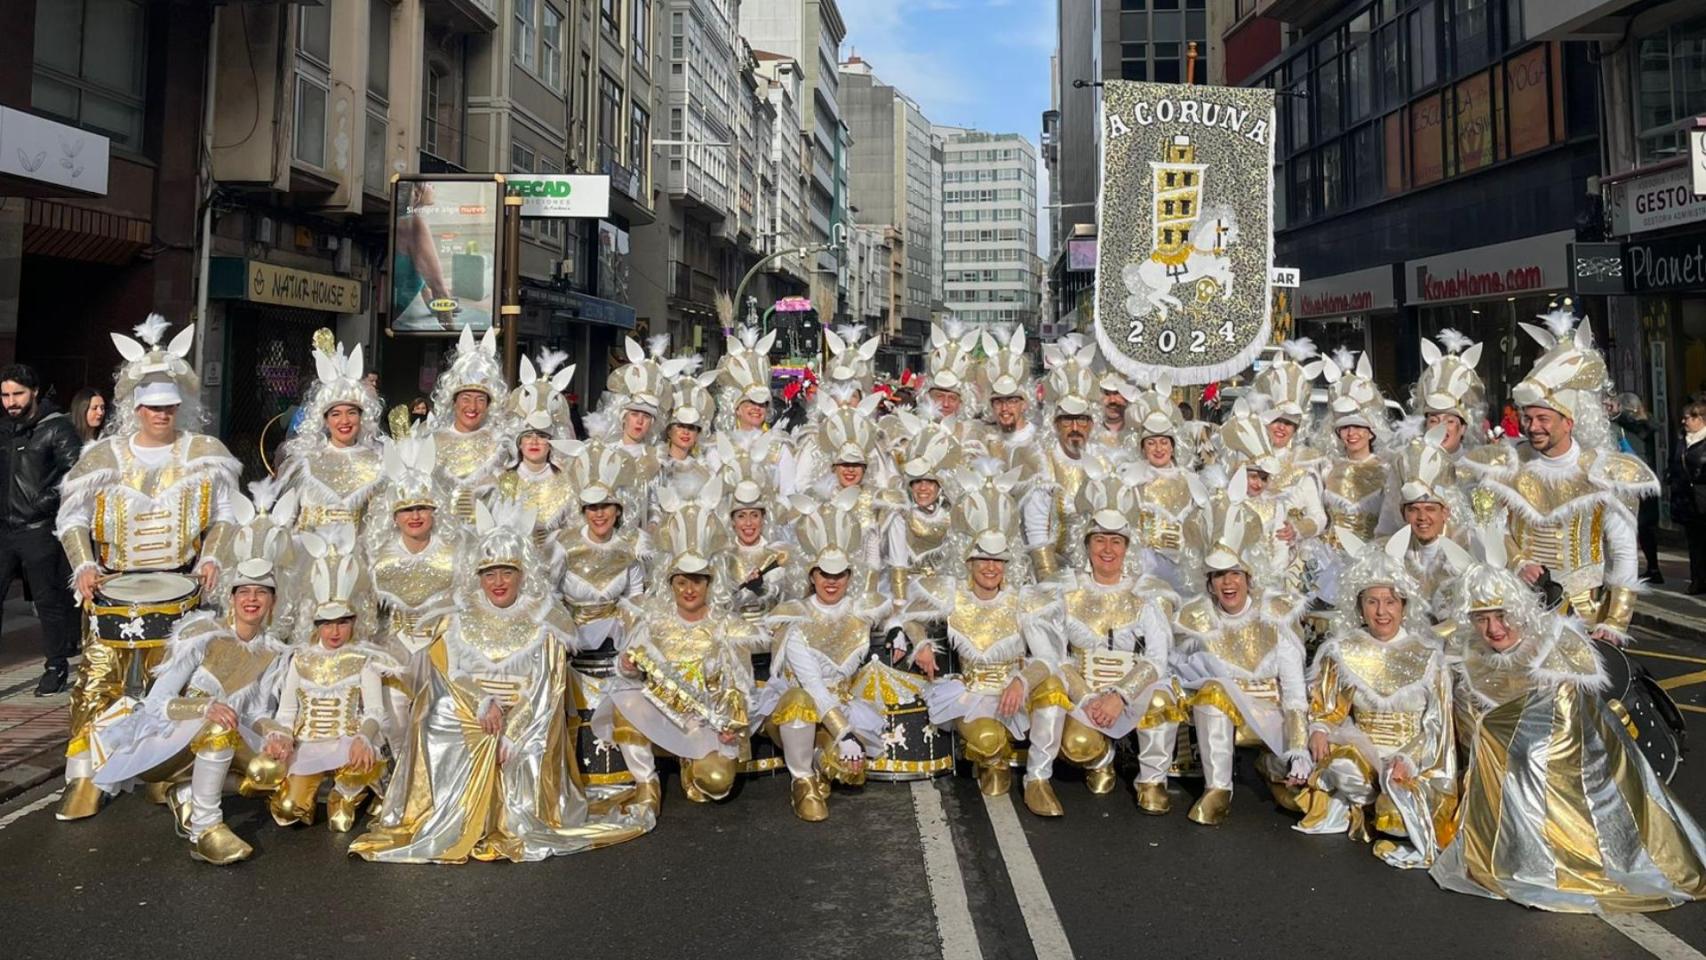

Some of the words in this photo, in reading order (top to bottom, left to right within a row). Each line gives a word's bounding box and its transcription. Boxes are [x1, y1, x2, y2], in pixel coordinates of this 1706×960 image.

[1109, 114, 1131, 138] A
[1636, 186, 1706, 214] GESTOR
[1271, 272, 1295, 285] AR
[1424, 265, 1544, 300] KaveHome.com
[1628, 244, 1706, 288] Planet
[272, 272, 309, 301] NATUR
[312, 280, 344, 306] HOUSE
[1127, 320, 1236, 353] 2024
